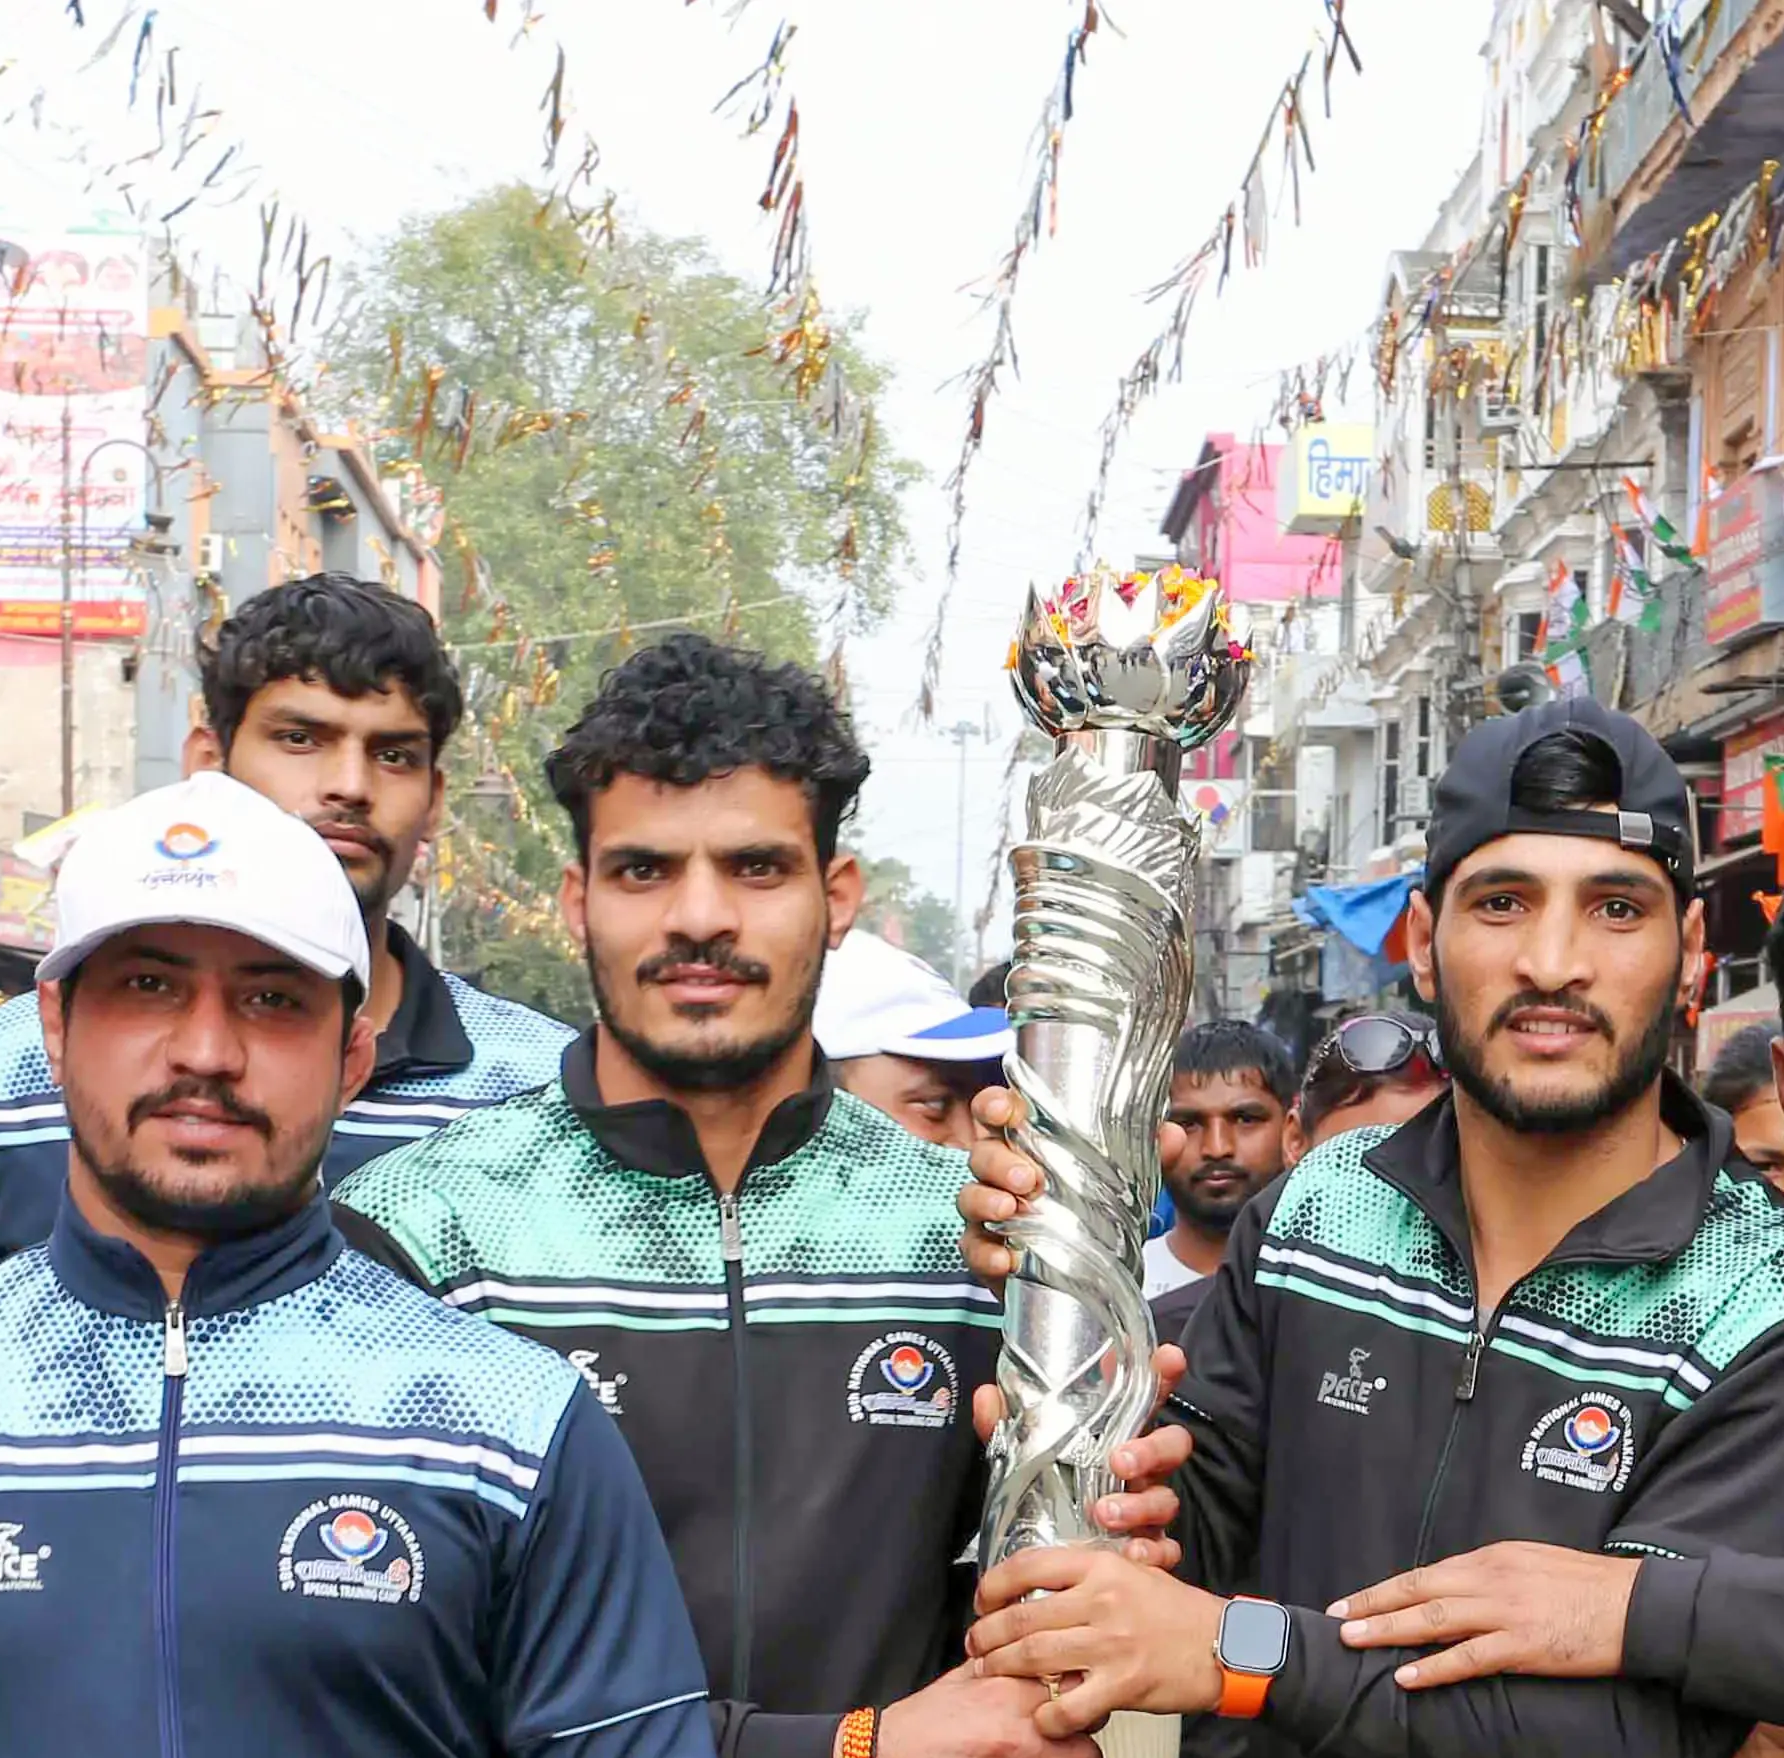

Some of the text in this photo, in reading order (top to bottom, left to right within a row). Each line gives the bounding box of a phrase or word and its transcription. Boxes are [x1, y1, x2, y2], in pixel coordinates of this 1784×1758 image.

[847, 1338, 889, 1391] NATIONAL
[1317, 1372, 1373, 1403] PACE
[1529, 1397, 1580, 1441] NATIONAL
[1580, 1391, 1622, 1412] GAMES
[279, 1499, 329, 1556] NATIONAL
[328, 1493, 380, 1514] GAMES
[379, 1504, 426, 1603] UTTARAKHAND
